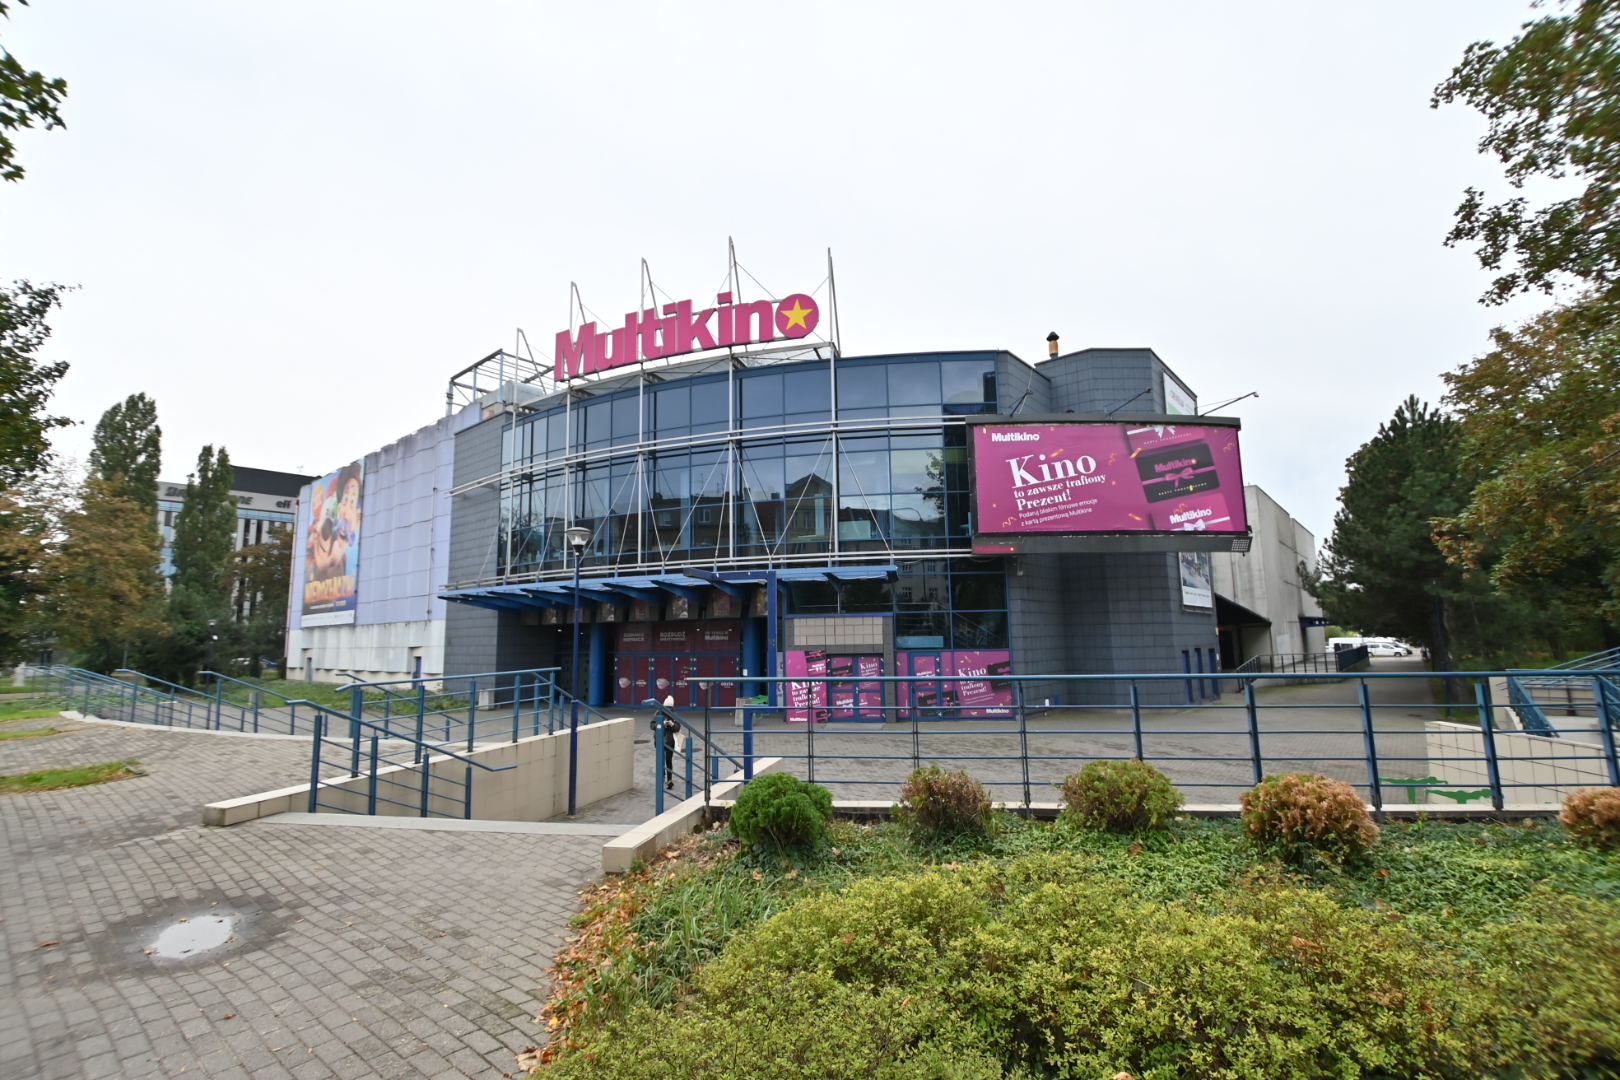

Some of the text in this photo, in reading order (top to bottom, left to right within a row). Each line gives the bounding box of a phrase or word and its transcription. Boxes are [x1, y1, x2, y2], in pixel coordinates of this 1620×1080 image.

[554, 291, 819, 382] Multikino
[991, 432, 1040, 442] Multikino
[1005, 453, 1097, 488] Kino
[1154, 458, 1198, 473] Multikino
[1013, 474, 1106, 499] to zawsze trafiony
[1016, 488, 1072, 511] Prezent!
[1018, 498, 1098, 519] Podaruj bliskim filmowe emocje
[1169, 508, 1213, 524] Multikino
[957, 667, 987, 678] Kino
